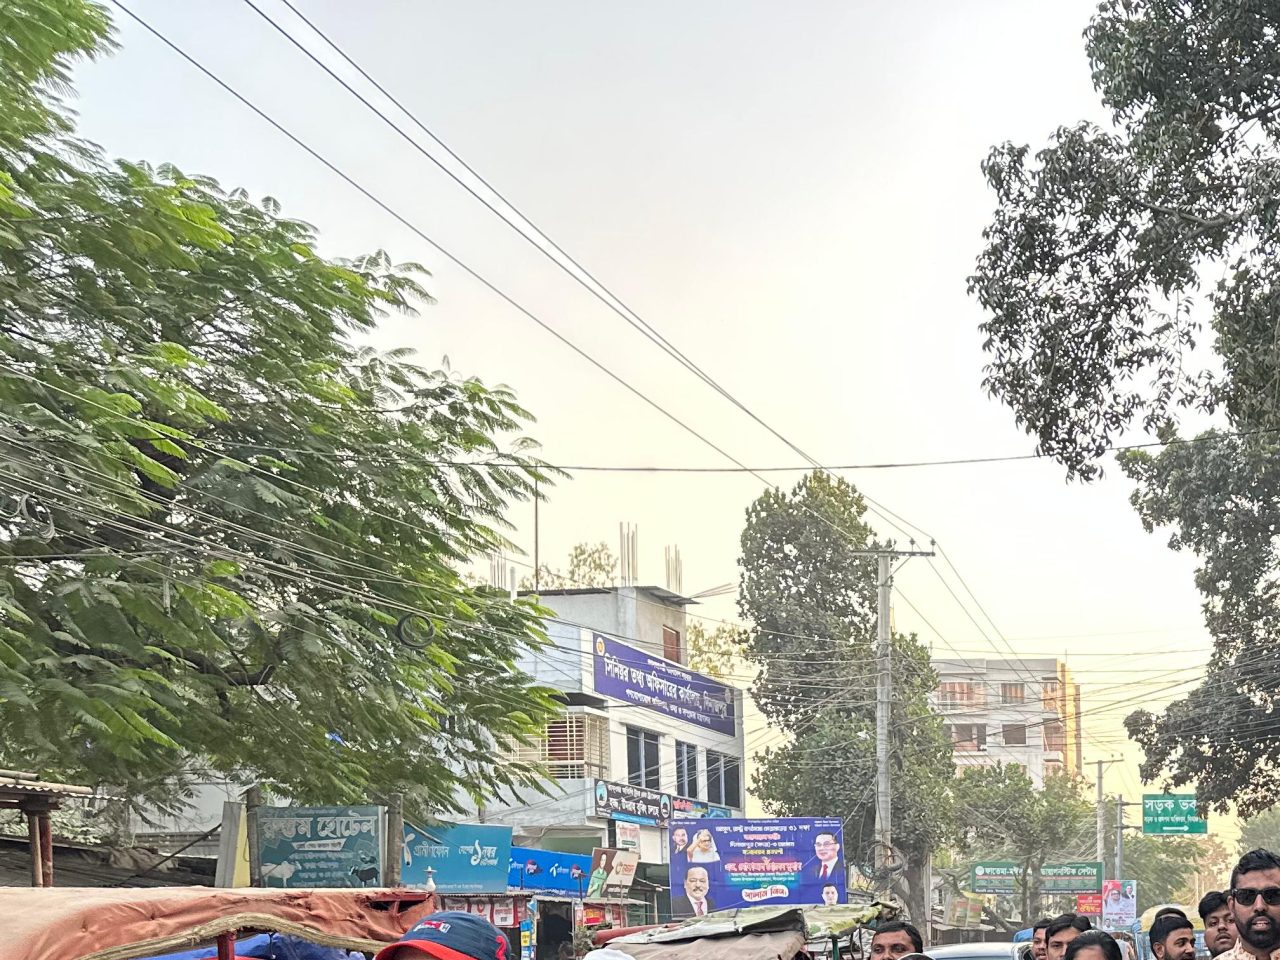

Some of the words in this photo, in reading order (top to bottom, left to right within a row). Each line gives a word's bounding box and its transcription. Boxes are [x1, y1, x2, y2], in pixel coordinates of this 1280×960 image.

[1144, 799, 1175, 814] সড়ক
[316, 809, 378, 838] হোটেল
[413, 841, 450, 859] গ্রামীণফোন
